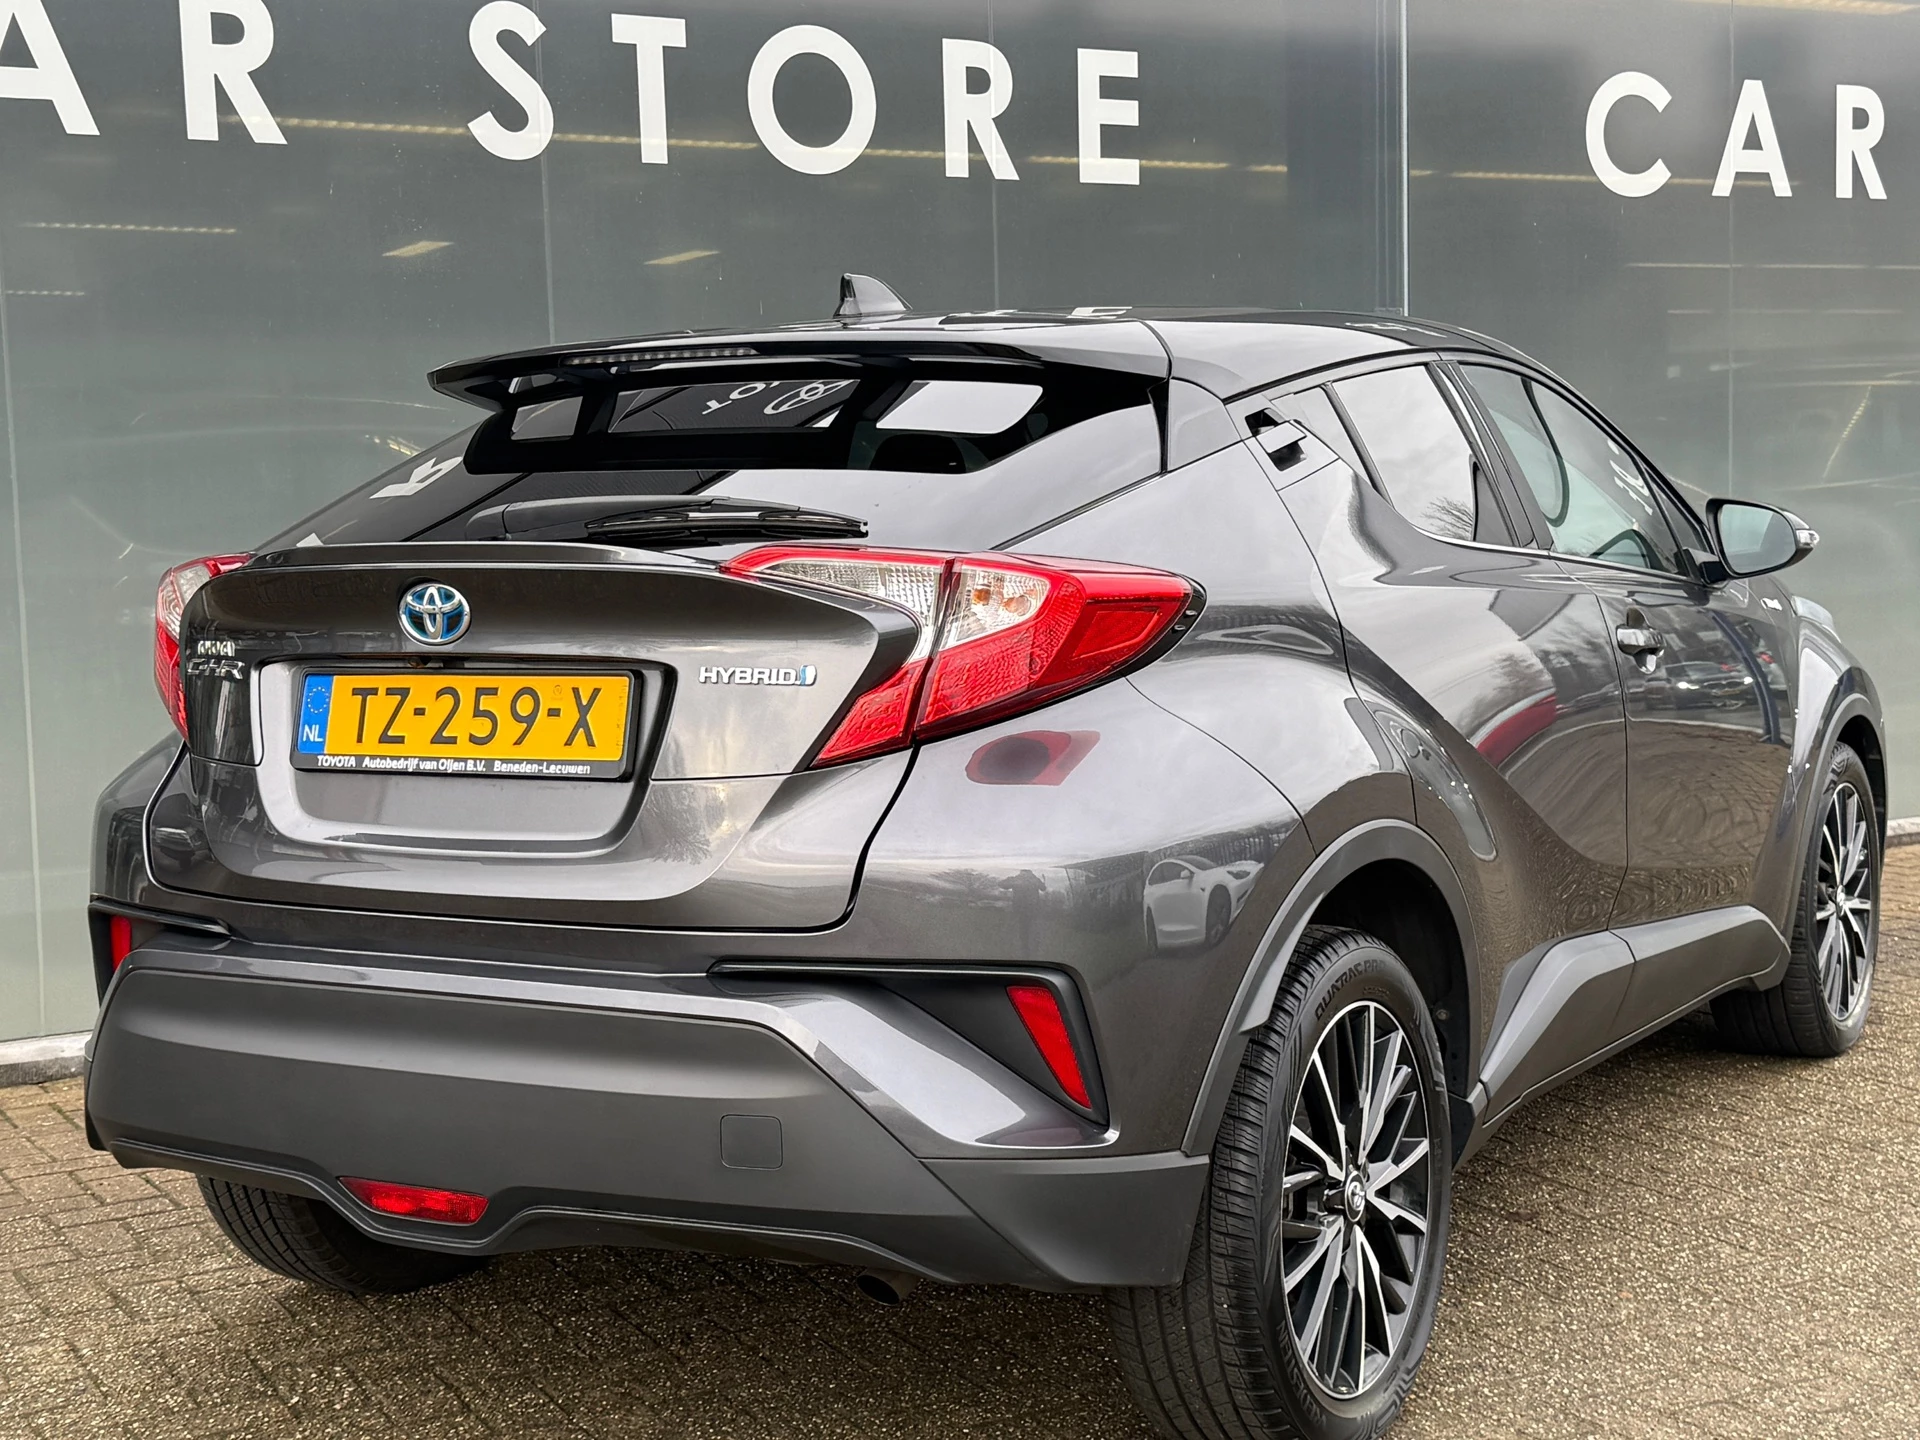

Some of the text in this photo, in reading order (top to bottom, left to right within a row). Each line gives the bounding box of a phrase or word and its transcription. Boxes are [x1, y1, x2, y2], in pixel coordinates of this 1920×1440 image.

[467, 0, 1140, 186] STORE
[1585, 71, 1888, 200] CAR
[699, 665, 797, 686] HYBRID
[303, 725, 323, 742] NL
[351, 686, 602, 748] TZ-259-X
[317, 755, 356, 768] TOYOTA
[362, 756, 419, 771] Autobedrijf
[420, 761, 437, 770] van
[466, 760, 486, 772] B.V.
